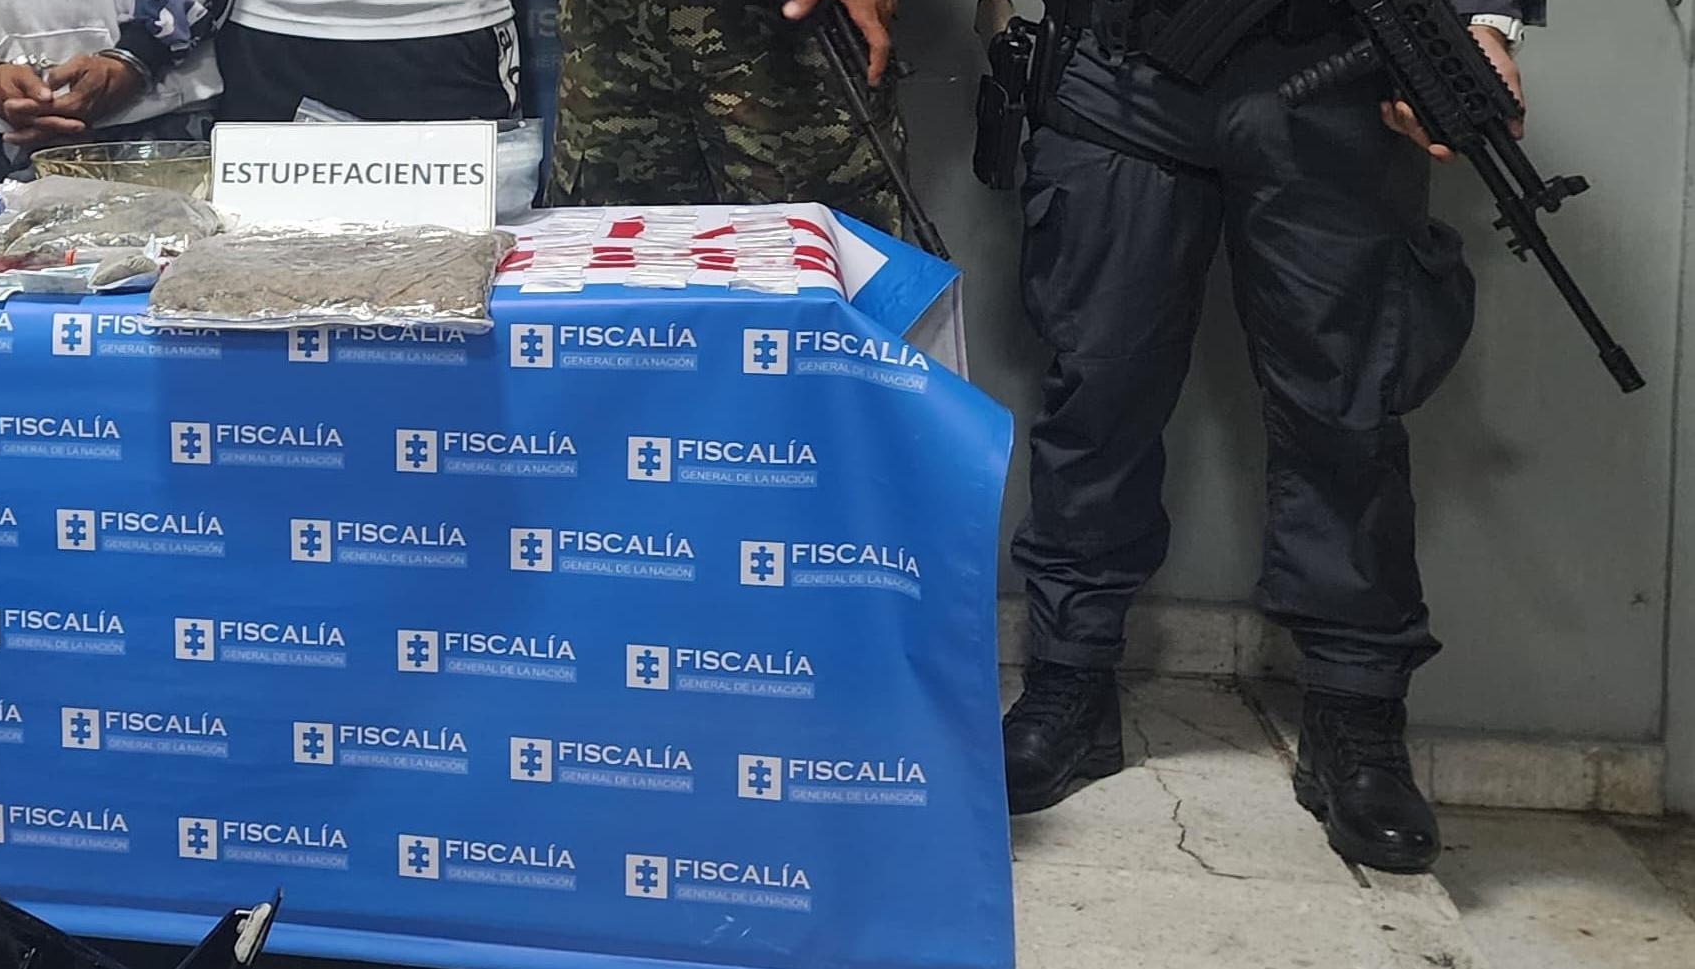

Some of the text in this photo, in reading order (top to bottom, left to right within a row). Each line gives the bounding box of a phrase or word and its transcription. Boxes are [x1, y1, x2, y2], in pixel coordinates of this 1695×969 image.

[221, 161, 485, 186] ESTUPEFACIENTES
[559, 322, 696, 349] FISCALÍA
[796, 330, 929, 370] FISCALÍA
[563, 355, 695, 367] GENERAL DE LA NACIÓN
[0, 414, 120, 440] FISCALÍA
[217, 423, 343, 447] FISCALÍA
[443, 430, 577, 456] FISCALÍA
[678, 437, 818, 466] FISCALÍA
[680, 470, 814, 485] GENERAL DE LA NACIÓN
[100, 510, 224, 536] FISCALÍA
[337, 521, 467, 547] FISCALÍA
[559, 530, 694, 559] FISCALÍA
[792, 542, 919, 578] FISCALÍA
[4, 609, 125, 636] FISCALÍA
[219, 620, 346, 649] FISCALÍA
[444, 631, 577, 661] FISCALÍA
[675, 648, 815, 677] FISCALÍA
[105, 710, 228, 738] FISCALÍA
[338, 724, 468, 754] FISCALÍA
[558, 741, 693, 772] FISCALÍA
[788, 758, 927, 785] FISCALÍA
[8, 804, 129, 833] FISCALÍA
[222, 821, 348, 850] FISCALÍA
[444, 839, 576, 870] FISCALÍA
[674, 859, 811, 891] FISCALÍA
